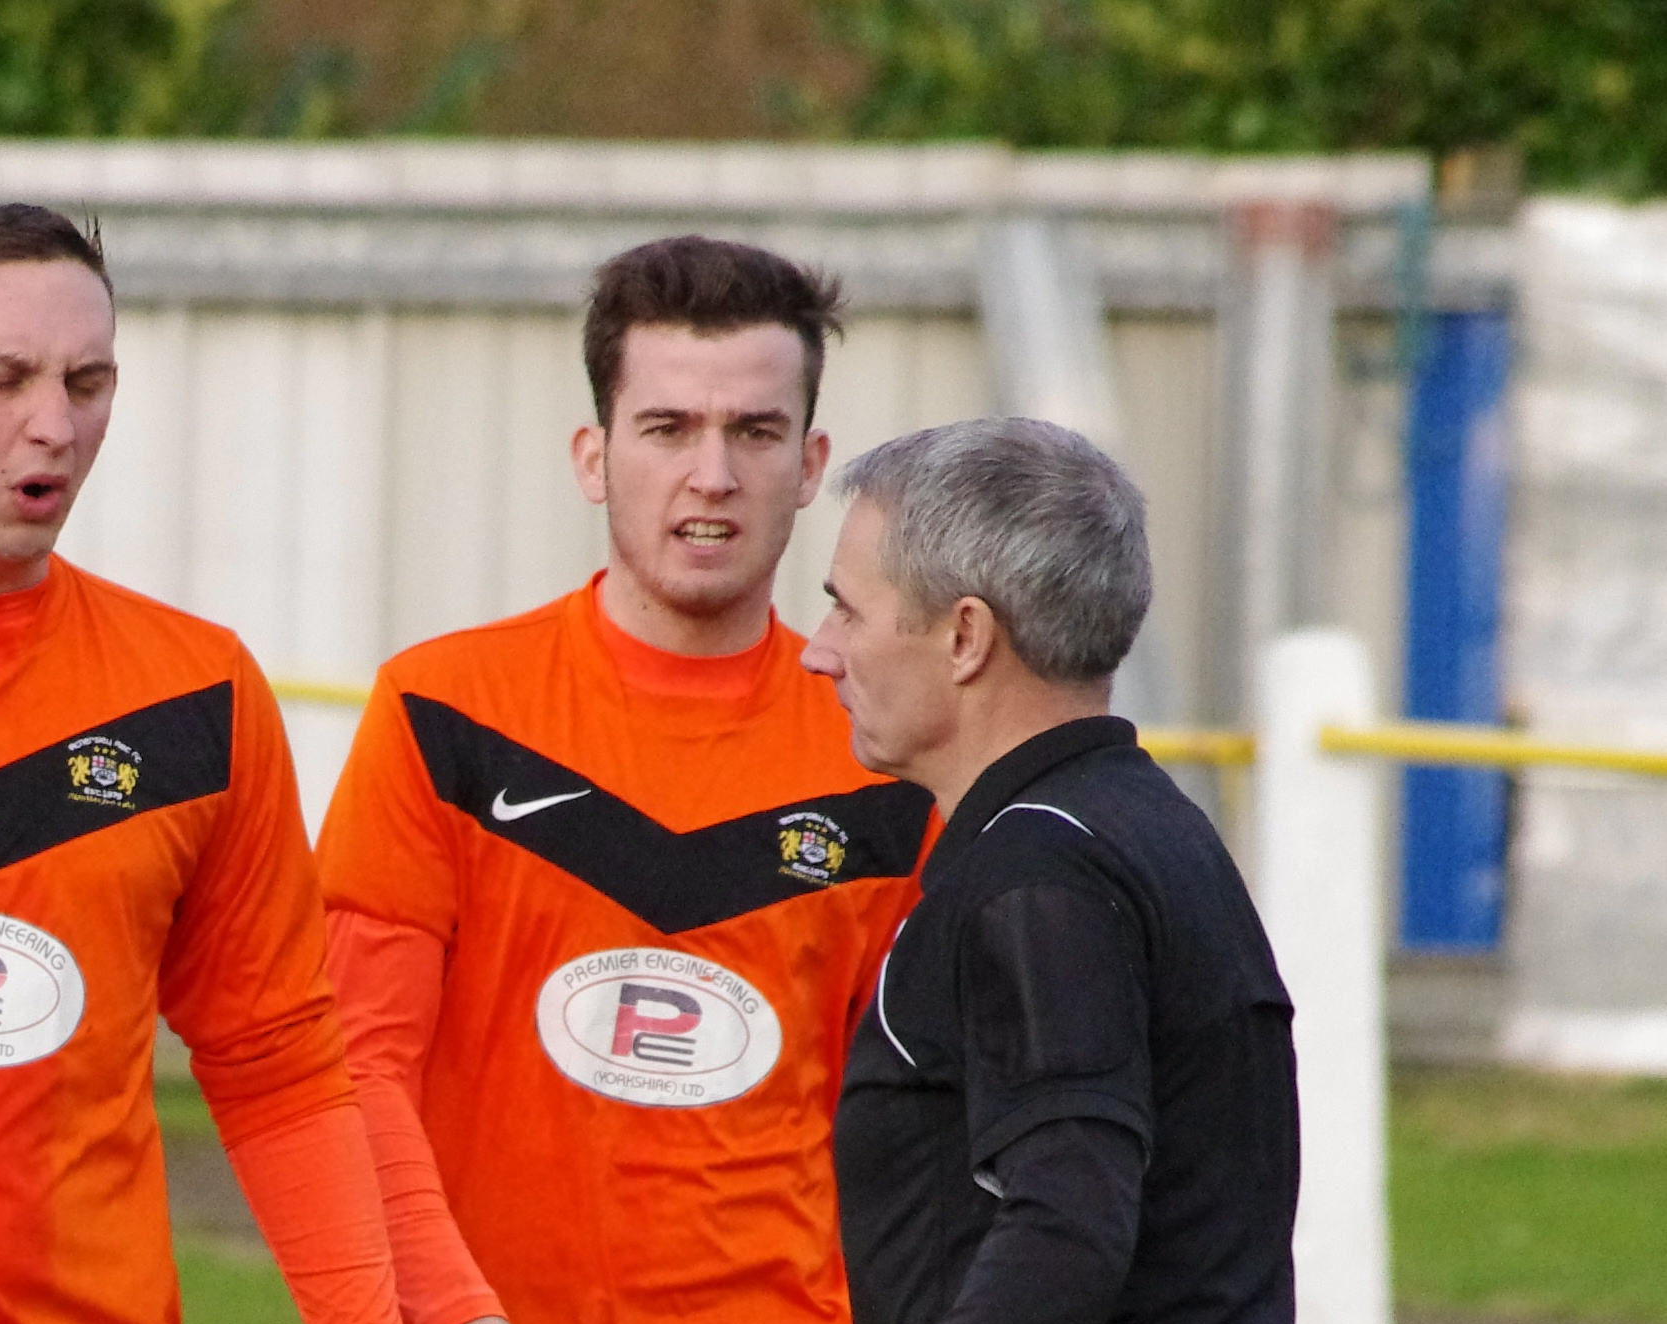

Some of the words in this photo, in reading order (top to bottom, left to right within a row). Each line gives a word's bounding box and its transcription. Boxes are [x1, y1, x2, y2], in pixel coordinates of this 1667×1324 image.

[563, 953, 639, 989] PREMIER
[645, 953, 759, 1015] ENGINEERING
[593, 1071, 677, 1095] (YORKSHIRE)
[682, 1083, 705, 1097] LTD
